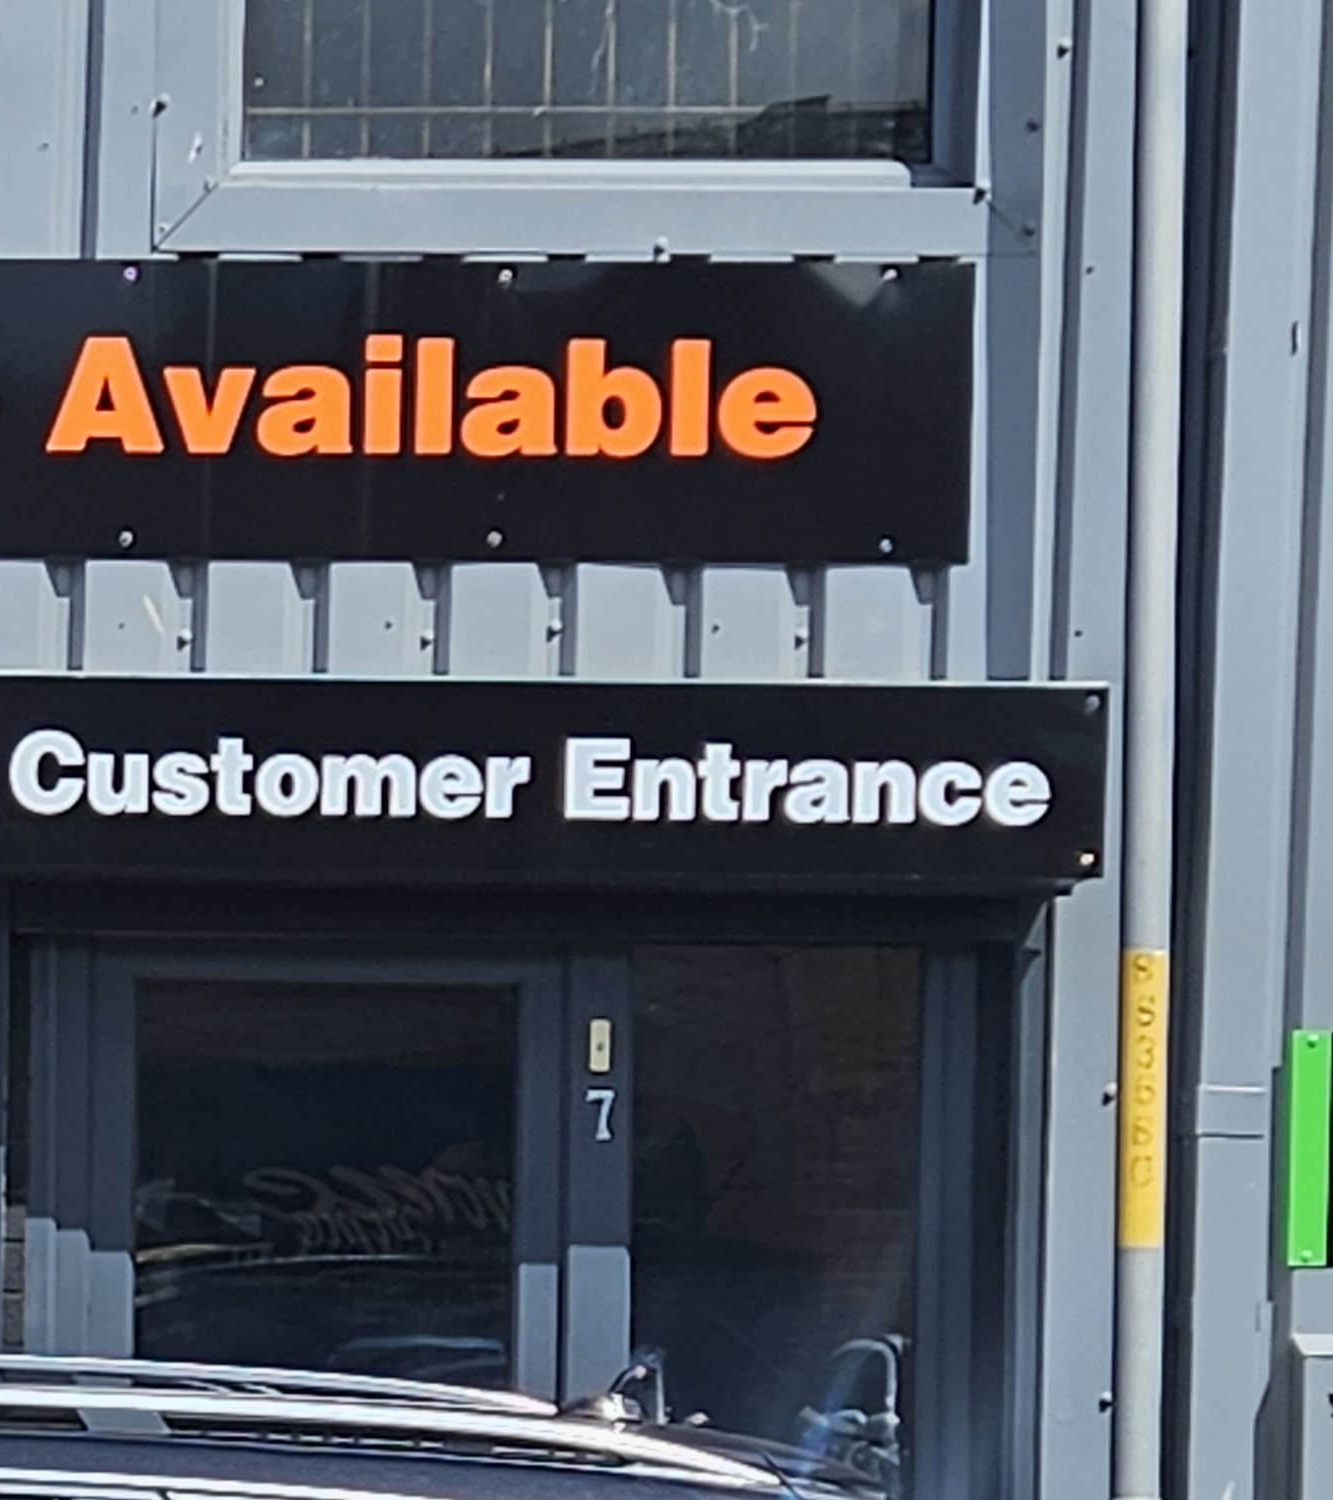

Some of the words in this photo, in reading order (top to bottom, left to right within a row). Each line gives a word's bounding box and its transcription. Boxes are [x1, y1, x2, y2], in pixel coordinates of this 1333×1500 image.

[45, 334, 817, 458] Available
[8, 729, 531, 819] Customer
[563, 737, 1051, 827] Entrance
[585, 1089, 616, 1142] 7
